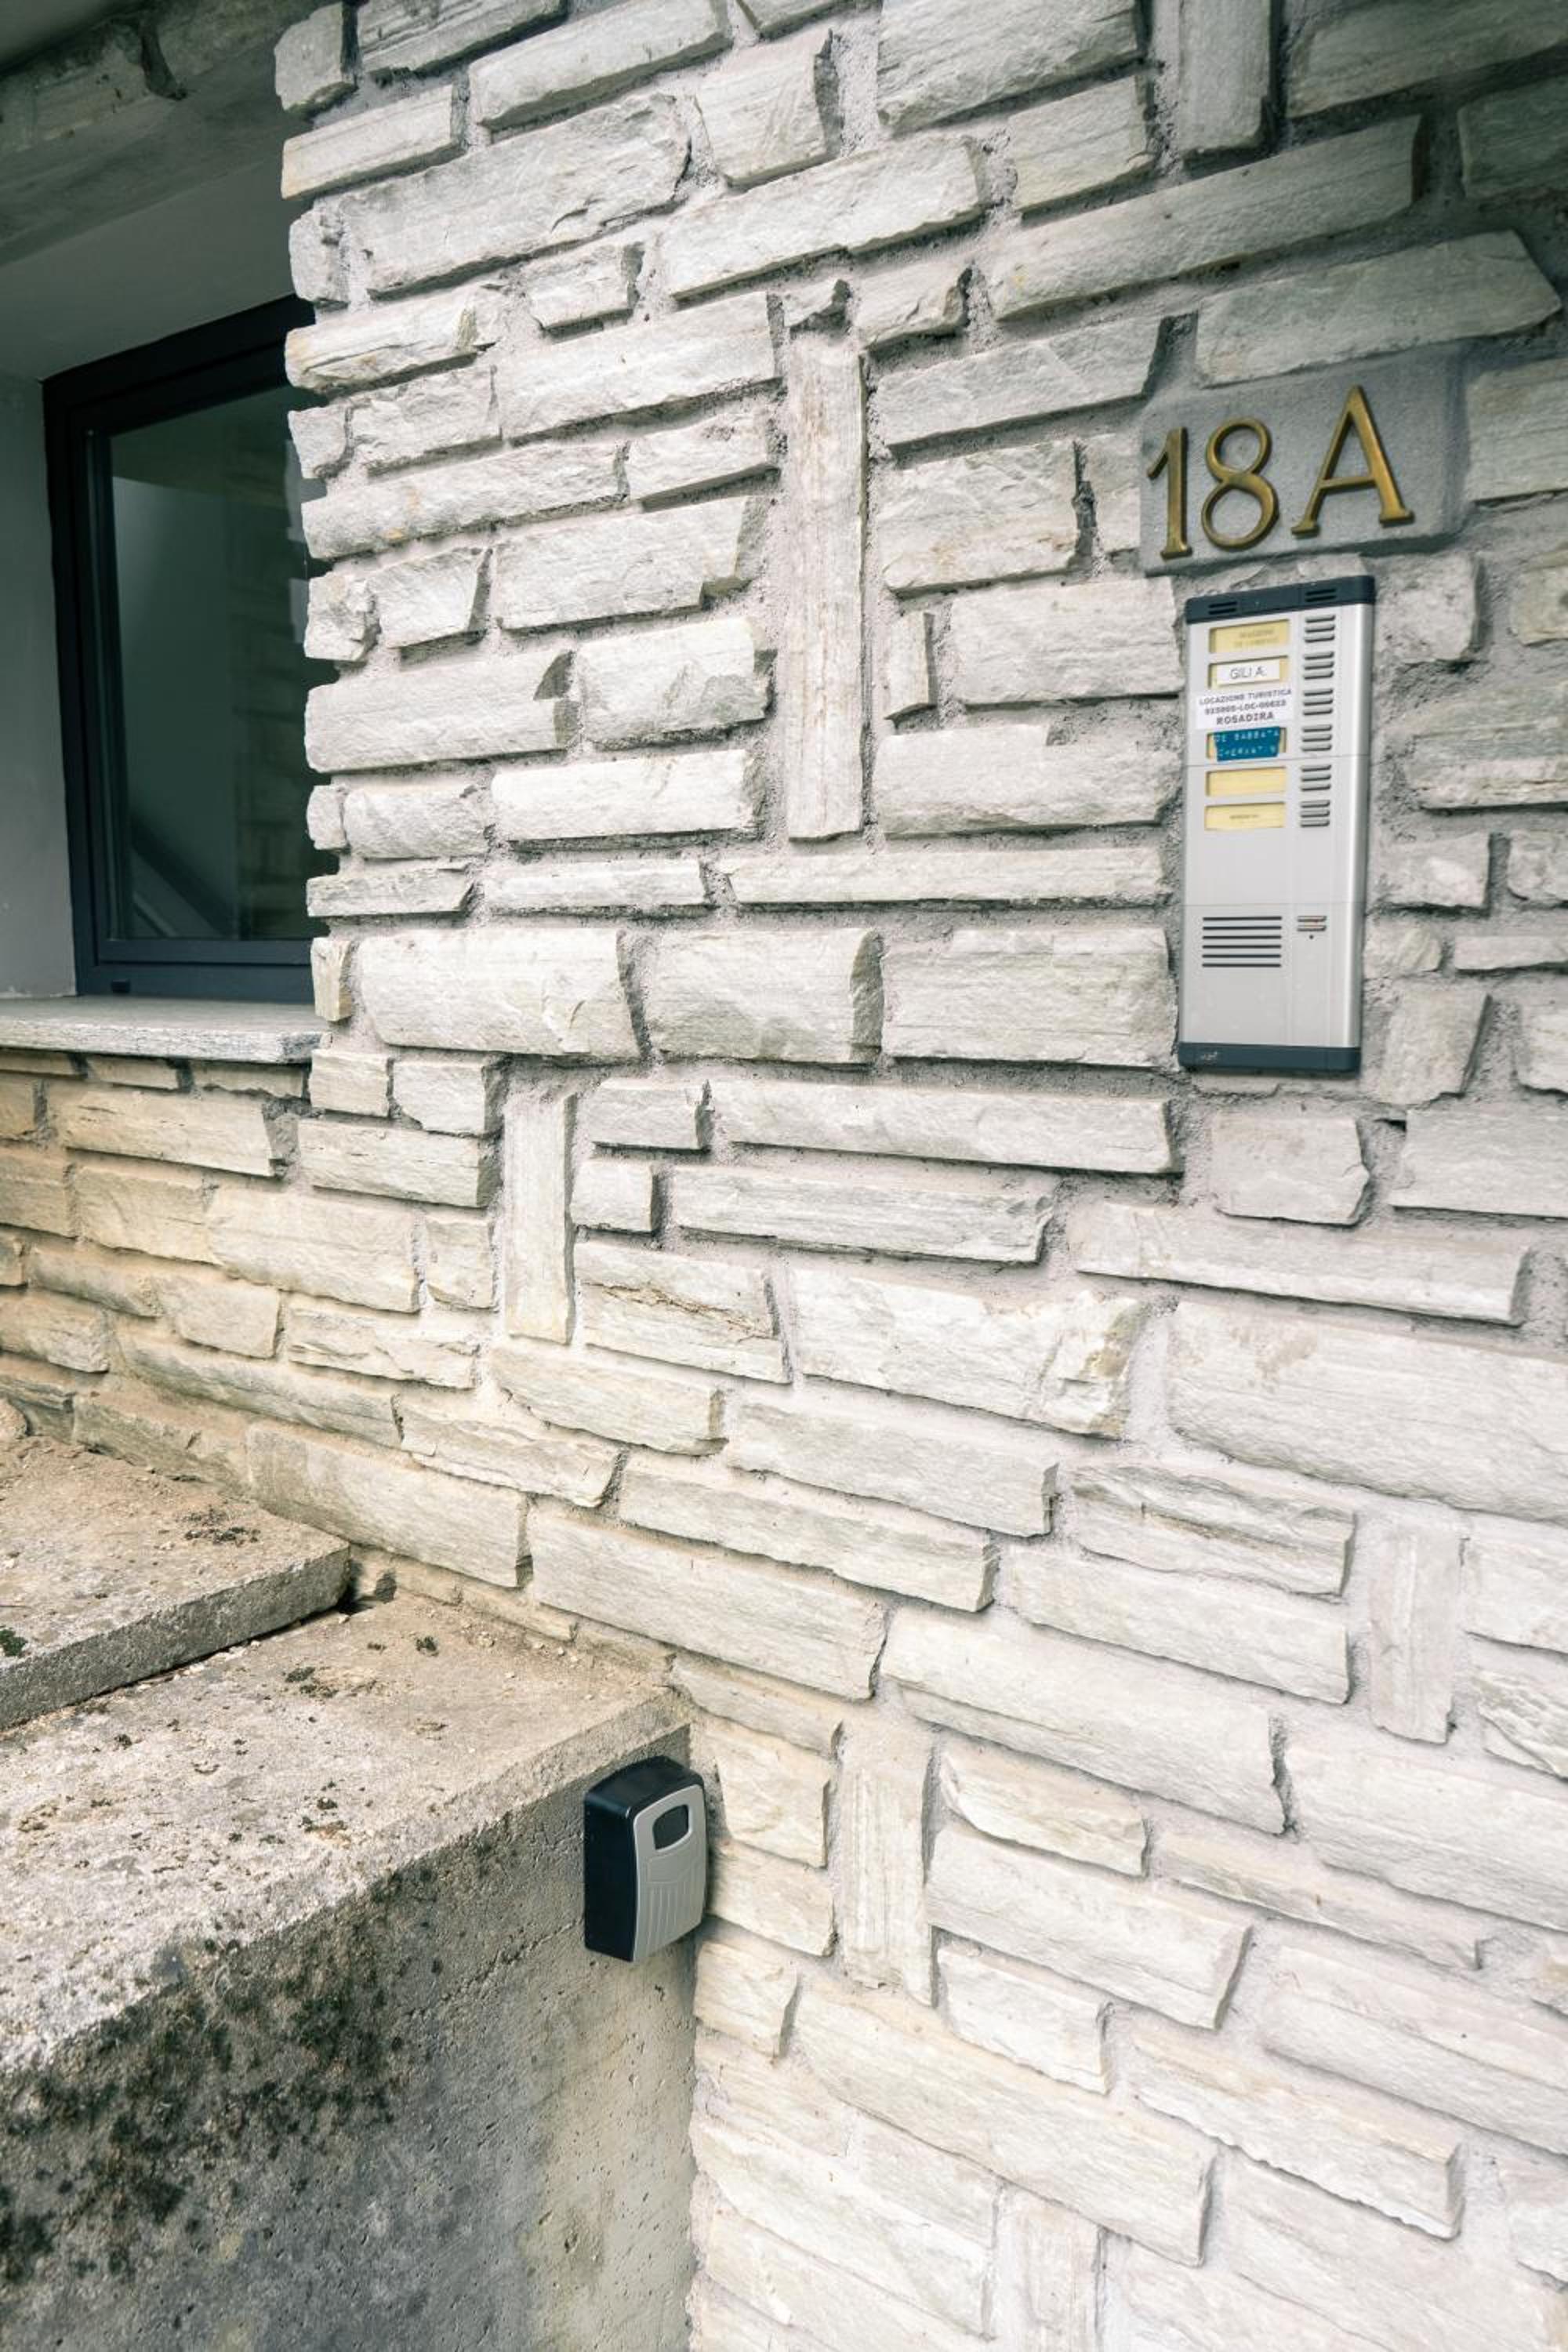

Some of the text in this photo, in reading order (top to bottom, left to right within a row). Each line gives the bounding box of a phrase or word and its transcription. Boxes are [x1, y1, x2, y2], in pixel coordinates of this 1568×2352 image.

[1147, 385, 1415, 560] 18A
[1199, 688, 1292, 706] LOCAZIONE TURISTICA
[1216, 711, 1275, 725] ROSADIRA
